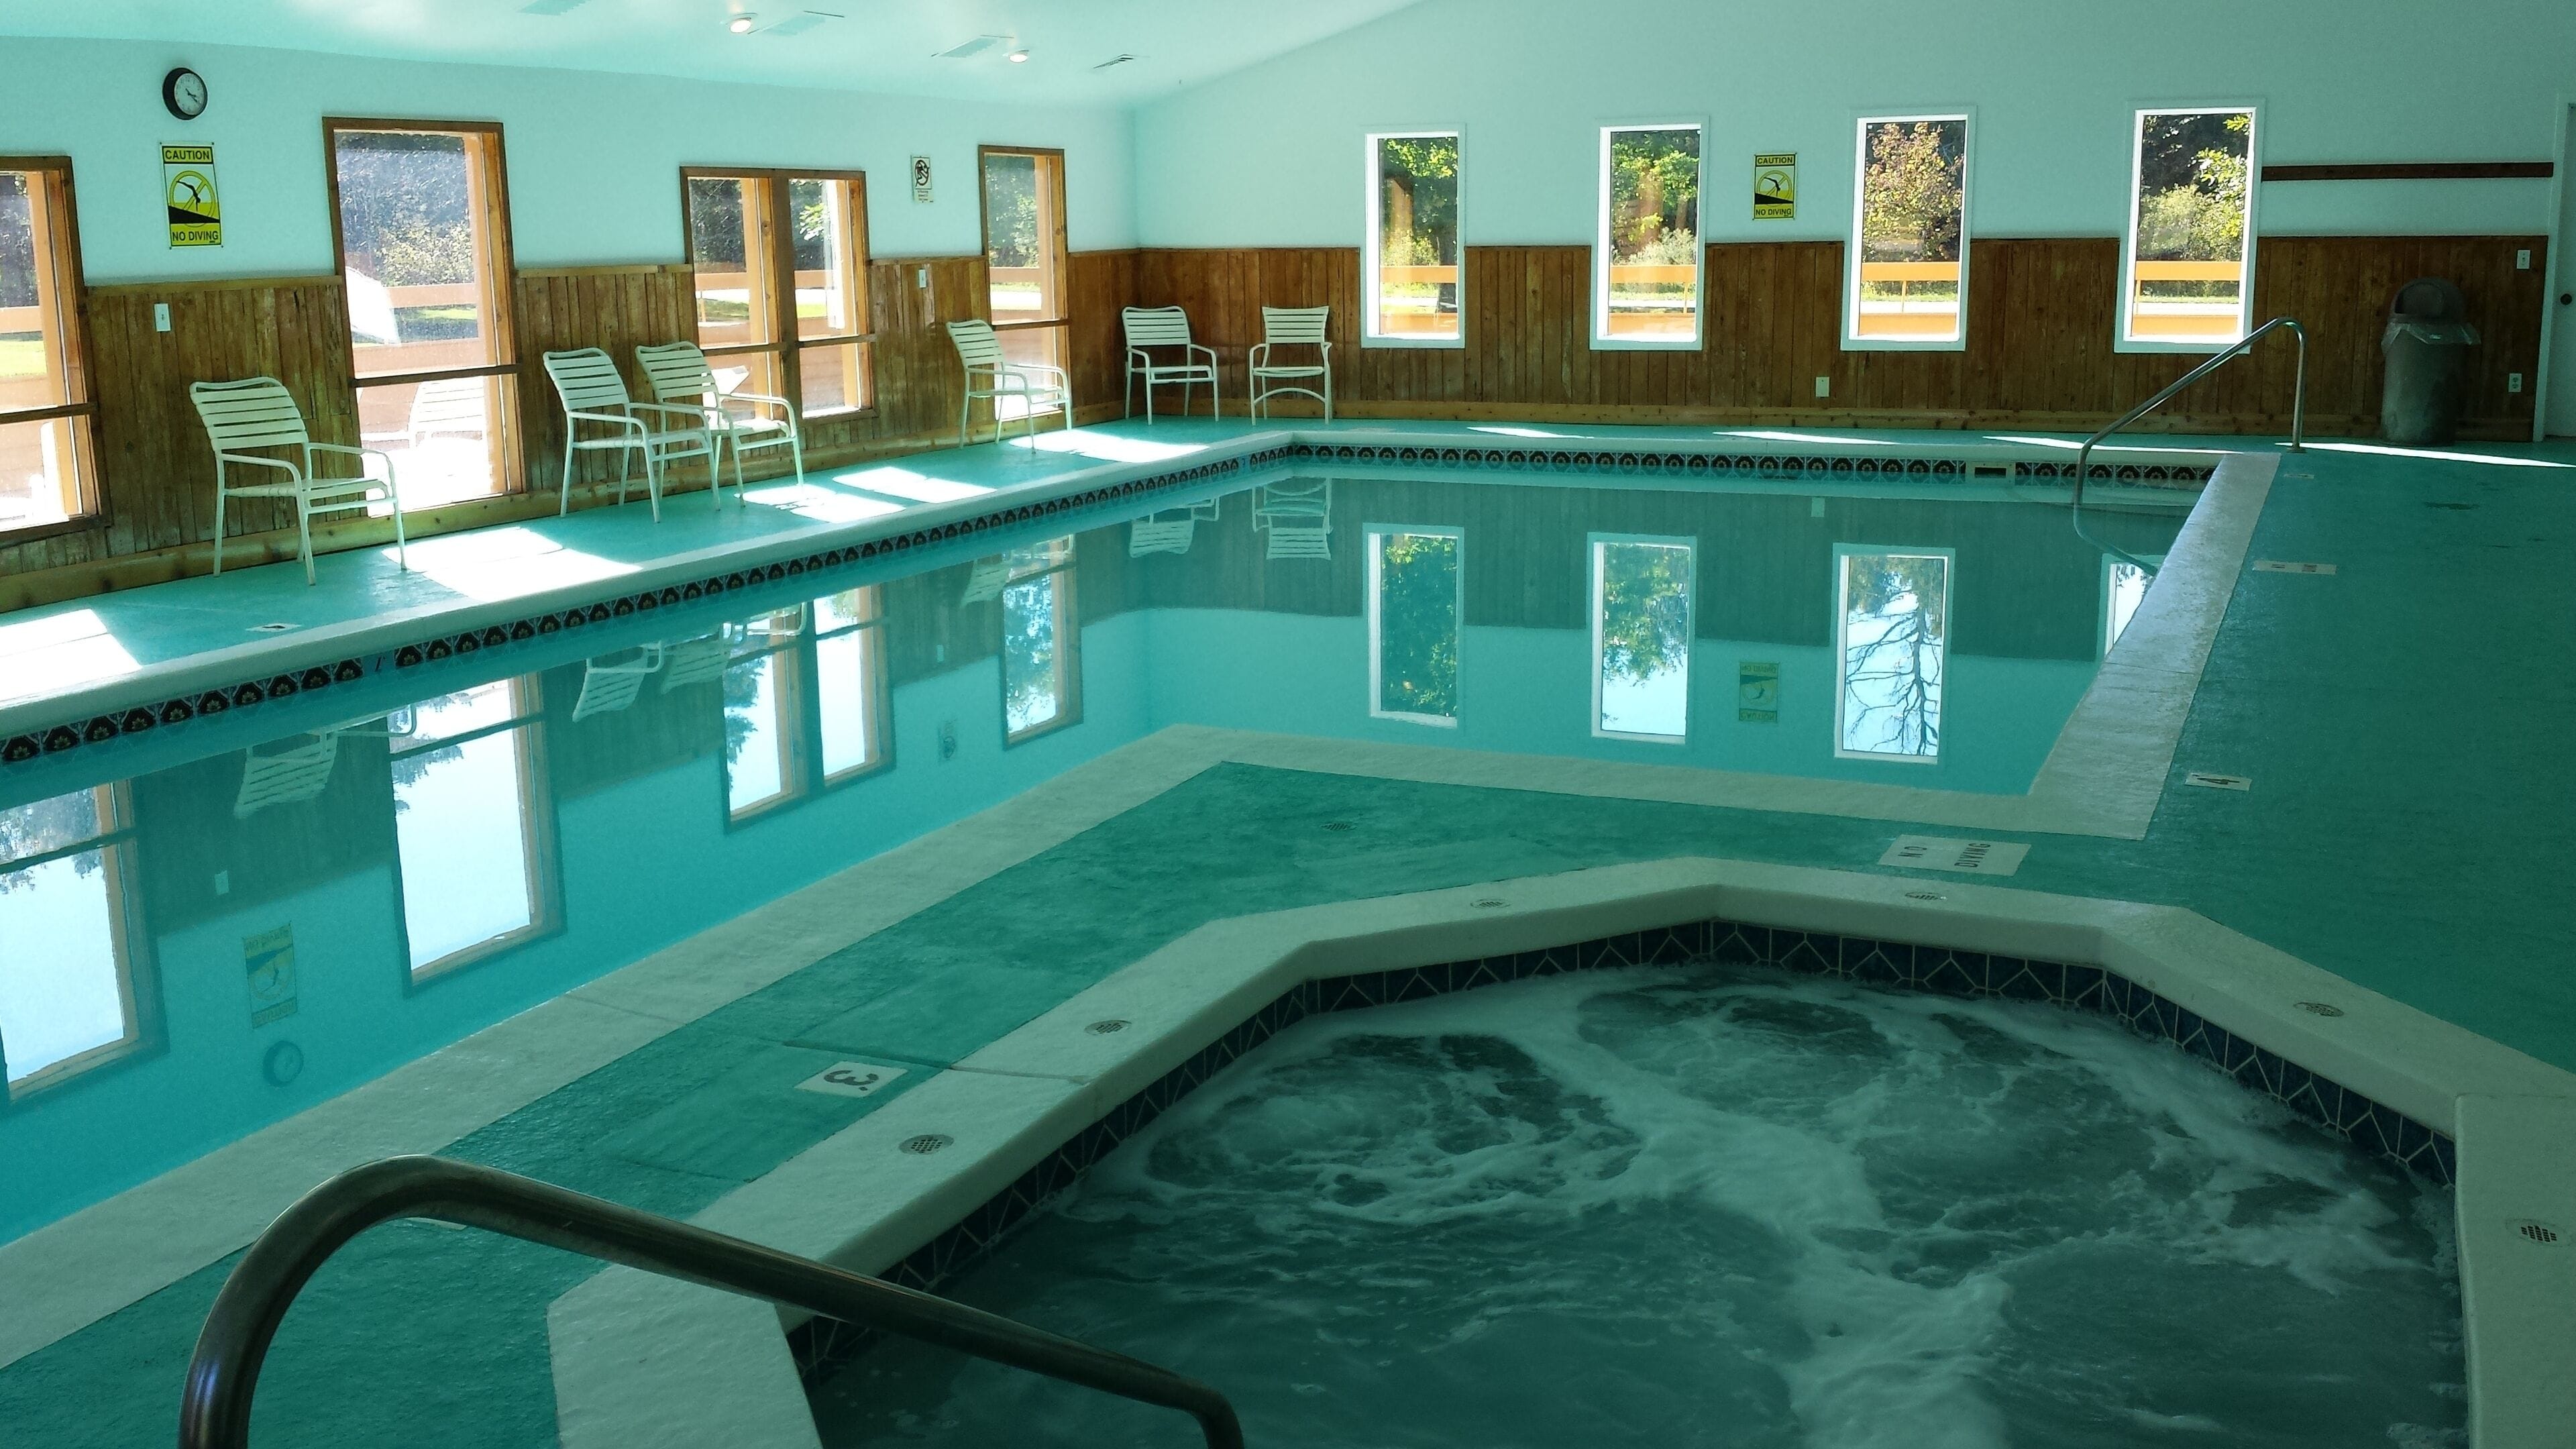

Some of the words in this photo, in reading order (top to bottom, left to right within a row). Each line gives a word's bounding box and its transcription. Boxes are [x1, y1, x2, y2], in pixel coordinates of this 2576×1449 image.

[165, 150, 210, 160] CAUTION
[1758, 156, 1792, 164] CAUTION
[172, 231, 185, 241] NO
[189, 231, 219, 241] DIVING
[1898, 846, 1927, 858] NO
[1954, 843, 1990, 867] DIVING
